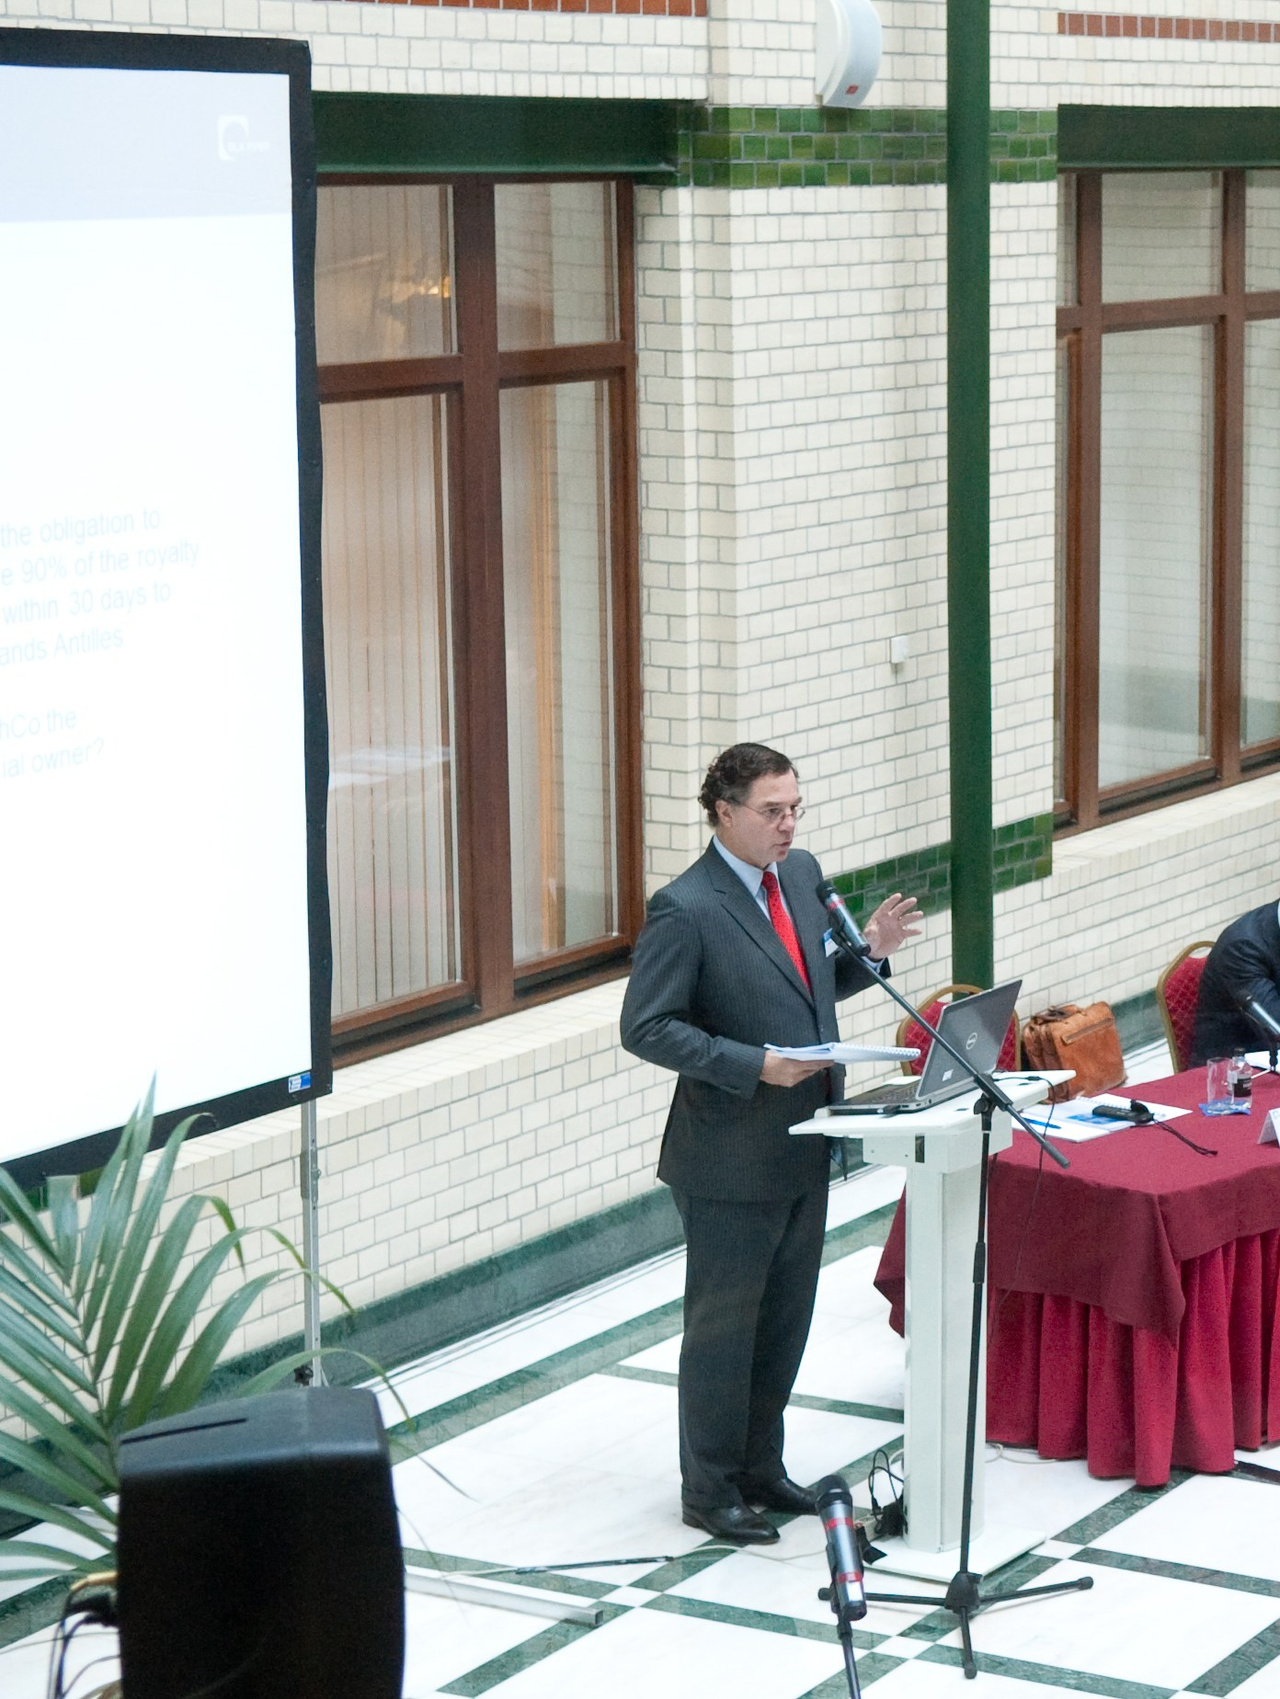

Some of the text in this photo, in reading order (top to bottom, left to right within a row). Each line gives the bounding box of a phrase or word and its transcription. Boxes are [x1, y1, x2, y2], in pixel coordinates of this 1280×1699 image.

[0, 507, 161, 548] the obligation to
[21, 556, 68, 583] 90%
[74, 550, 95, 577] of
[100, 551, 130, 573] the
[137, 539, 200, 573] royalty
[3, 580, 172, 625] within 30 days to
[53, 626, 124, 658] Antilles
[46, 708, 77, 733] the
[31, 736, 105, 773] owner?
